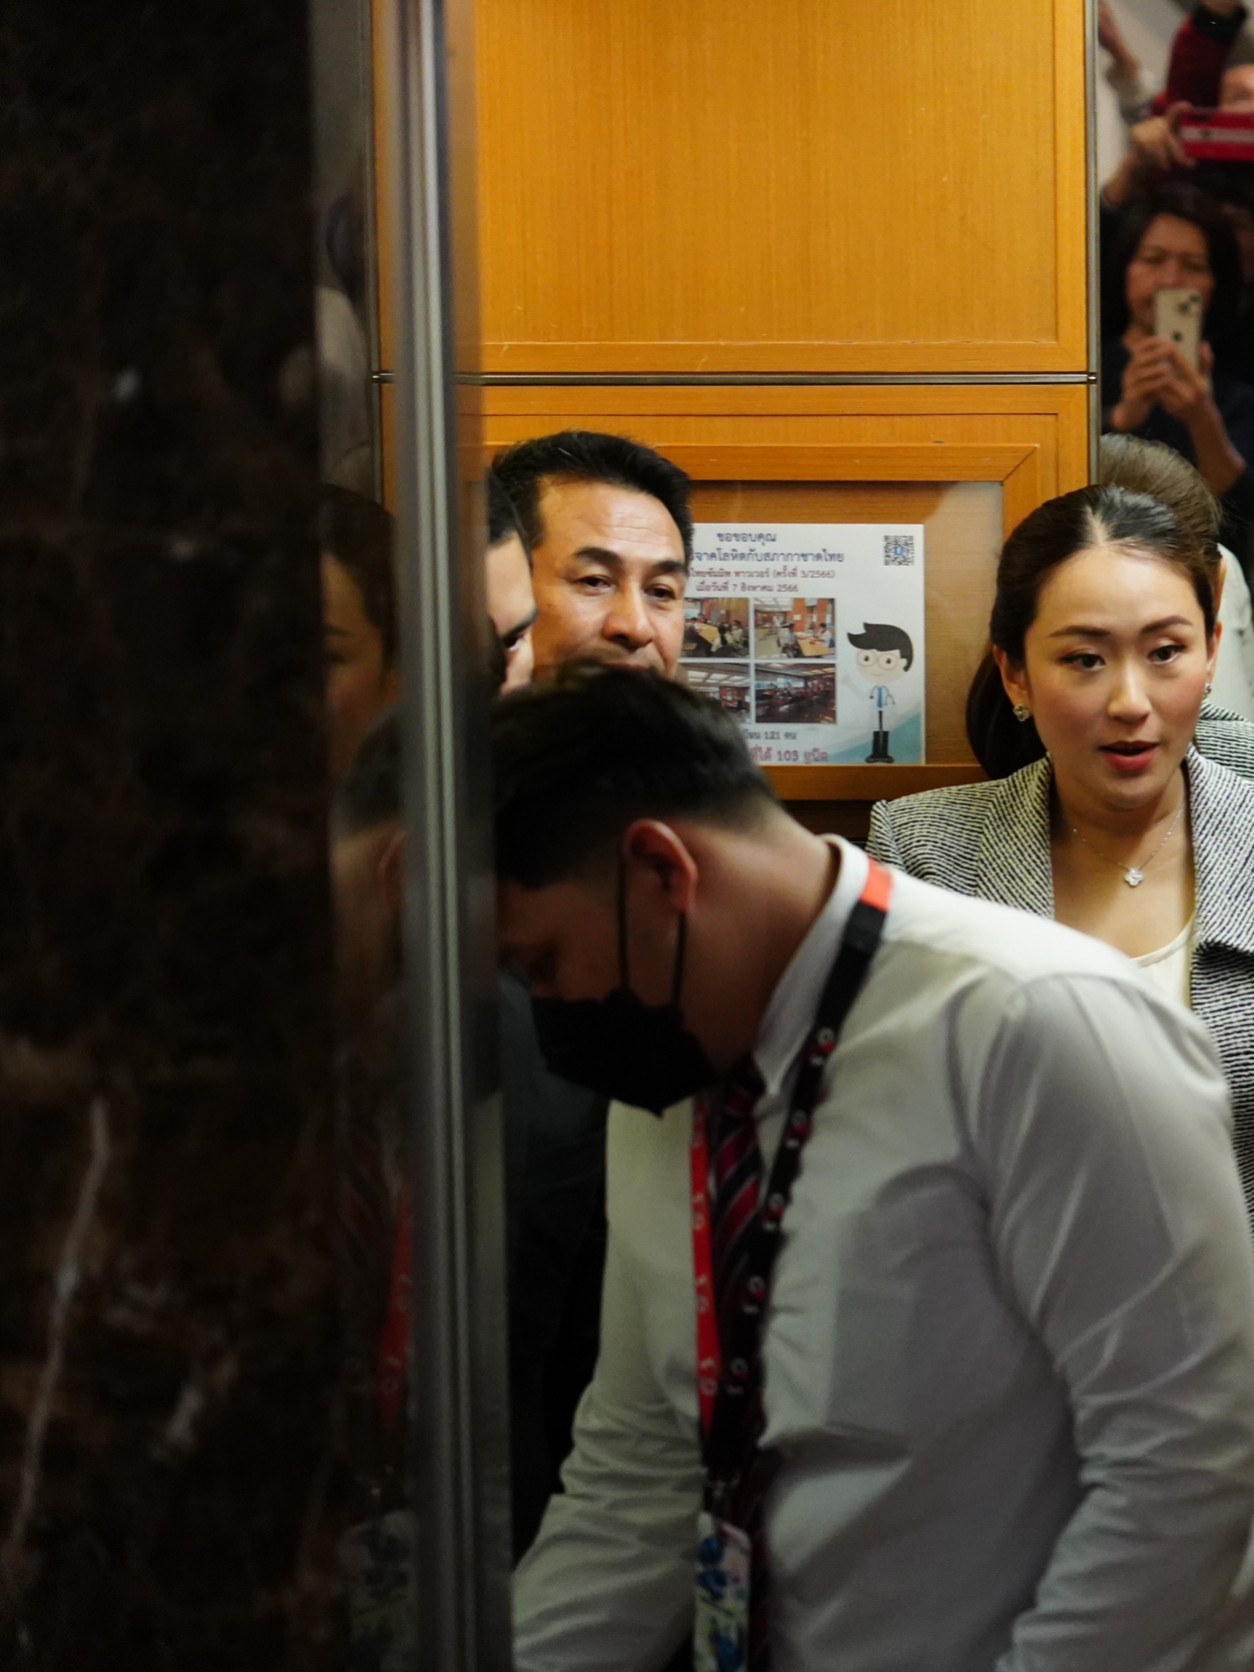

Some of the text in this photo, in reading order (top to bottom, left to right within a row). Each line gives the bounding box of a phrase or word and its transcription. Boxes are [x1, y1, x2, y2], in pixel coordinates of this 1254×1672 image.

[716, 533, 777, 546] ขอขอบคุณ
[732, 584, 739, 593] 7
[776, 584, 799, 593] 2566
[764, 731, 780, 740] 121
